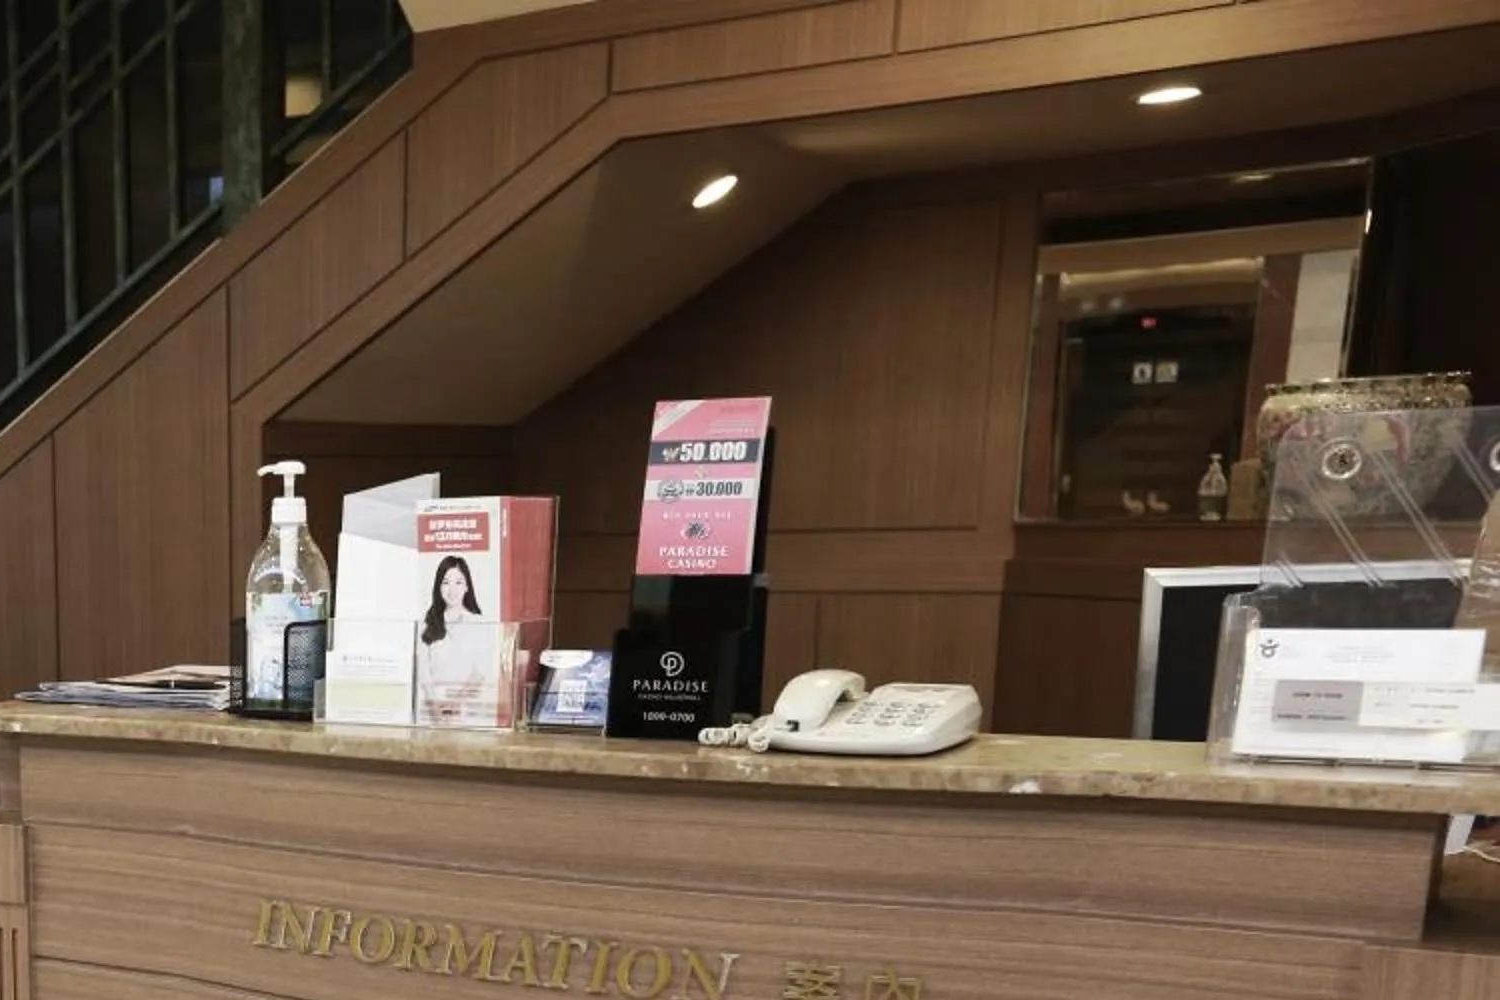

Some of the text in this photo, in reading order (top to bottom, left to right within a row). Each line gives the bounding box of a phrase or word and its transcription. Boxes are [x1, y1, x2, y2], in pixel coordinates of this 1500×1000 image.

[659, 545, 730, 558] PARADISE
[667, 558, 717, 569] CASINO
[632, 679, 709, 693] PARADISE
